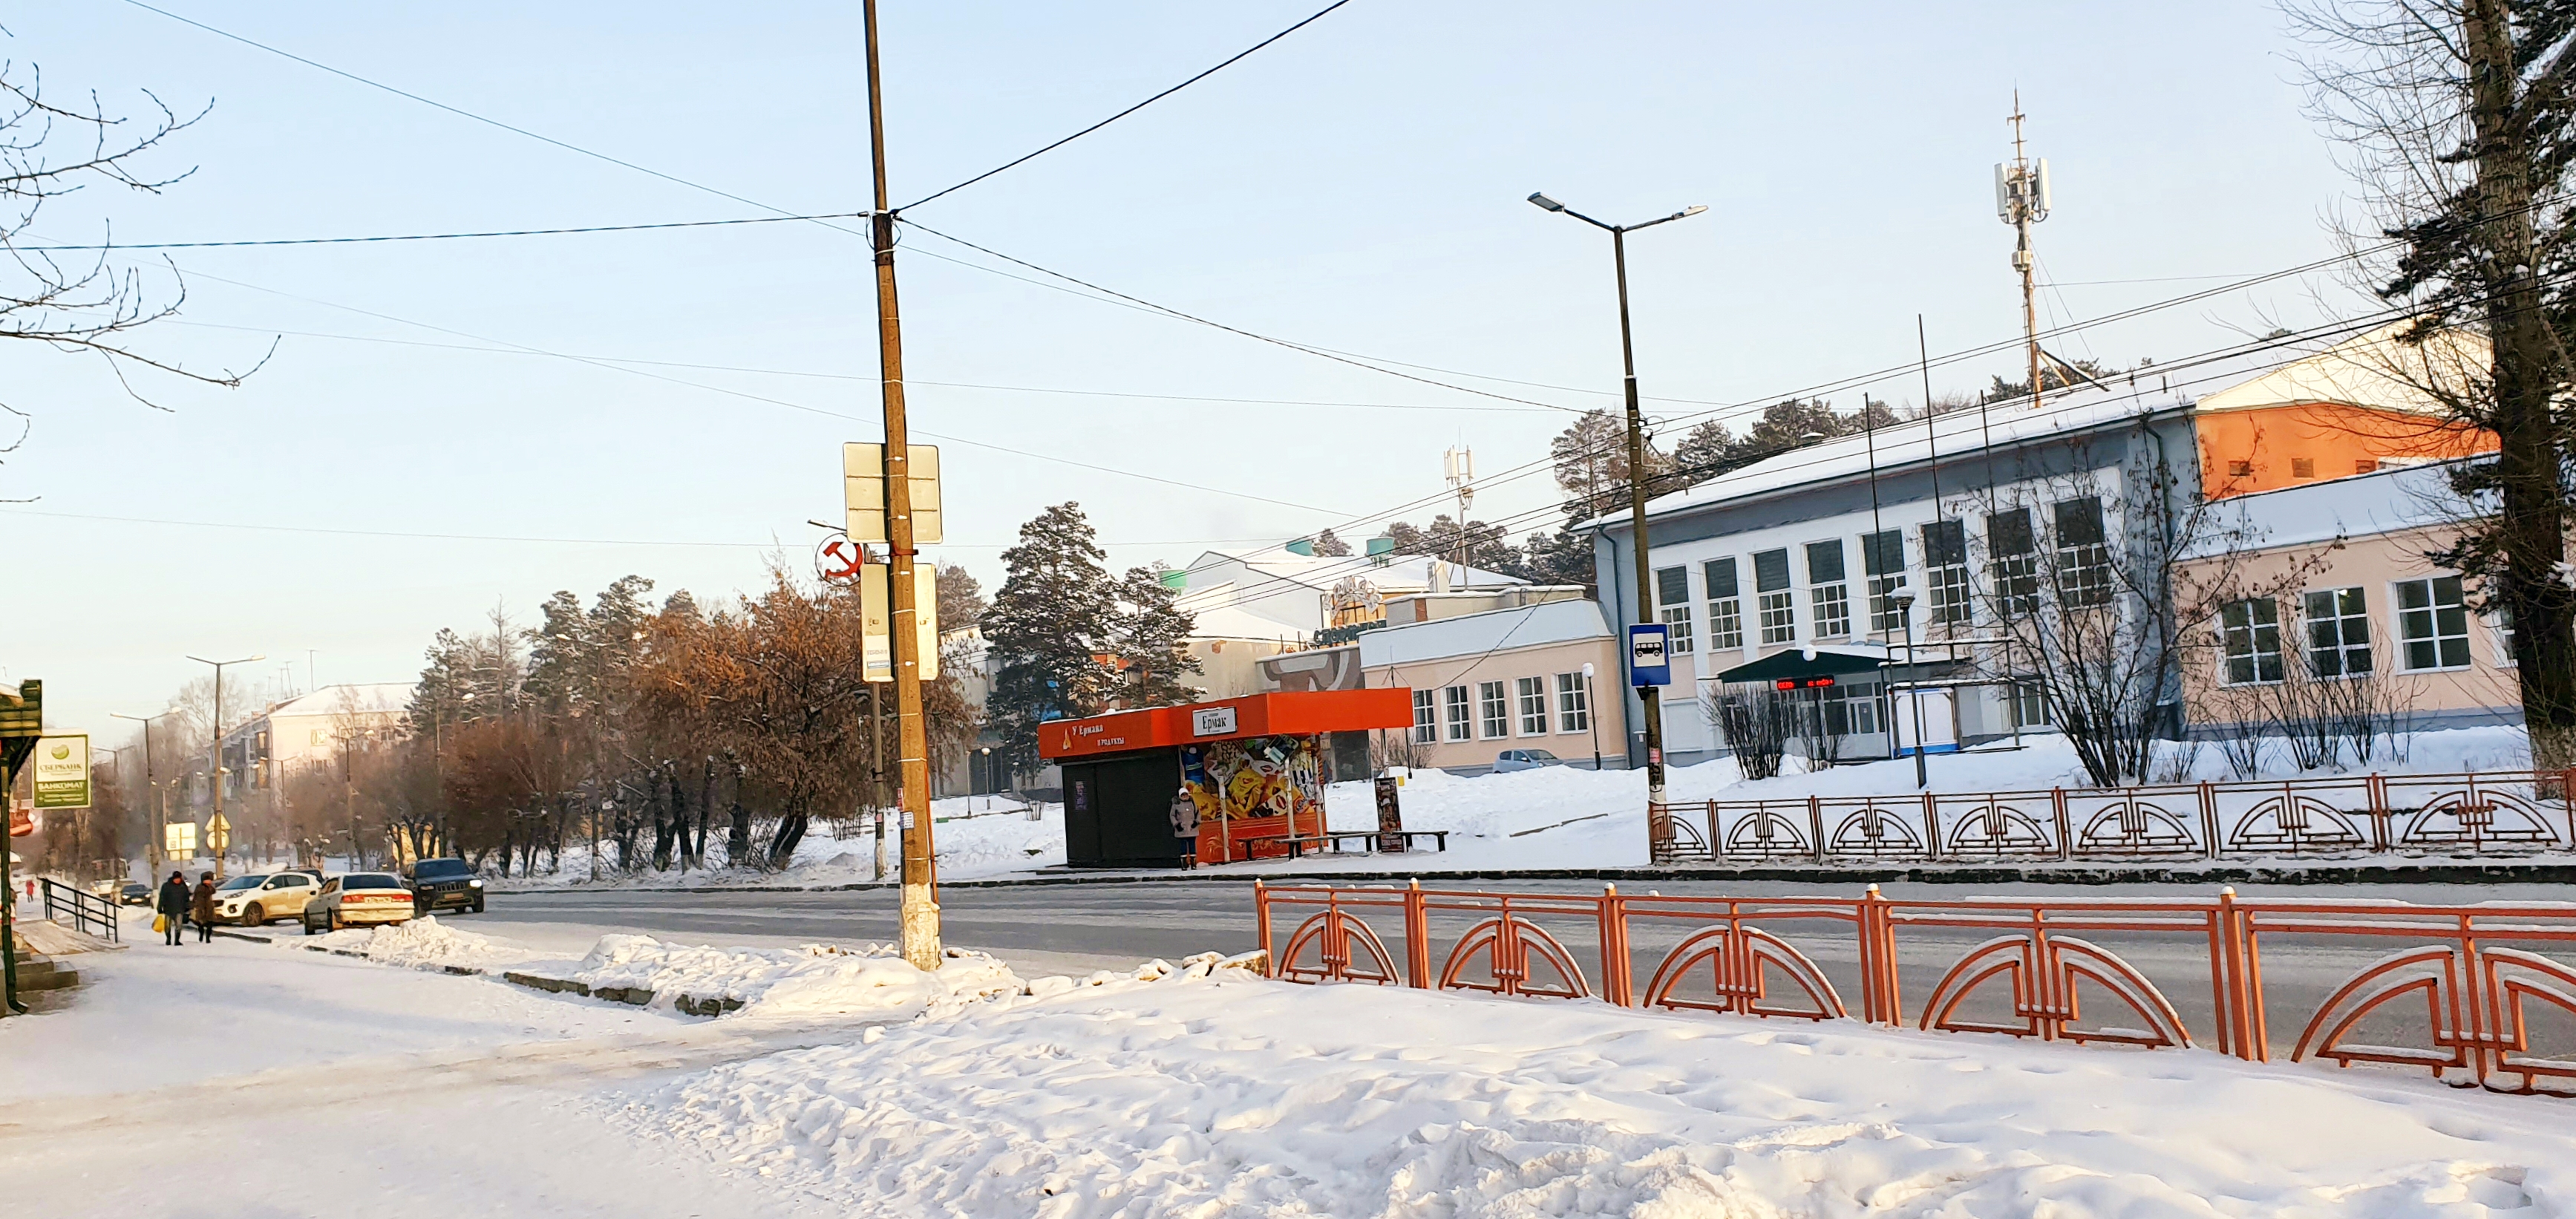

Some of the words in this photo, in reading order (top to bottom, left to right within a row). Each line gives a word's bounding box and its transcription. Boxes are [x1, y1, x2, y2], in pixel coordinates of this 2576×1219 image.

[1203, 715, 1226, 733] Ермак
[1072, 725, 1077, 736] У
[39, 763, 82, 771] СБЕРБАНК
[38, 782, 84, 790] БАНКОМАТ
